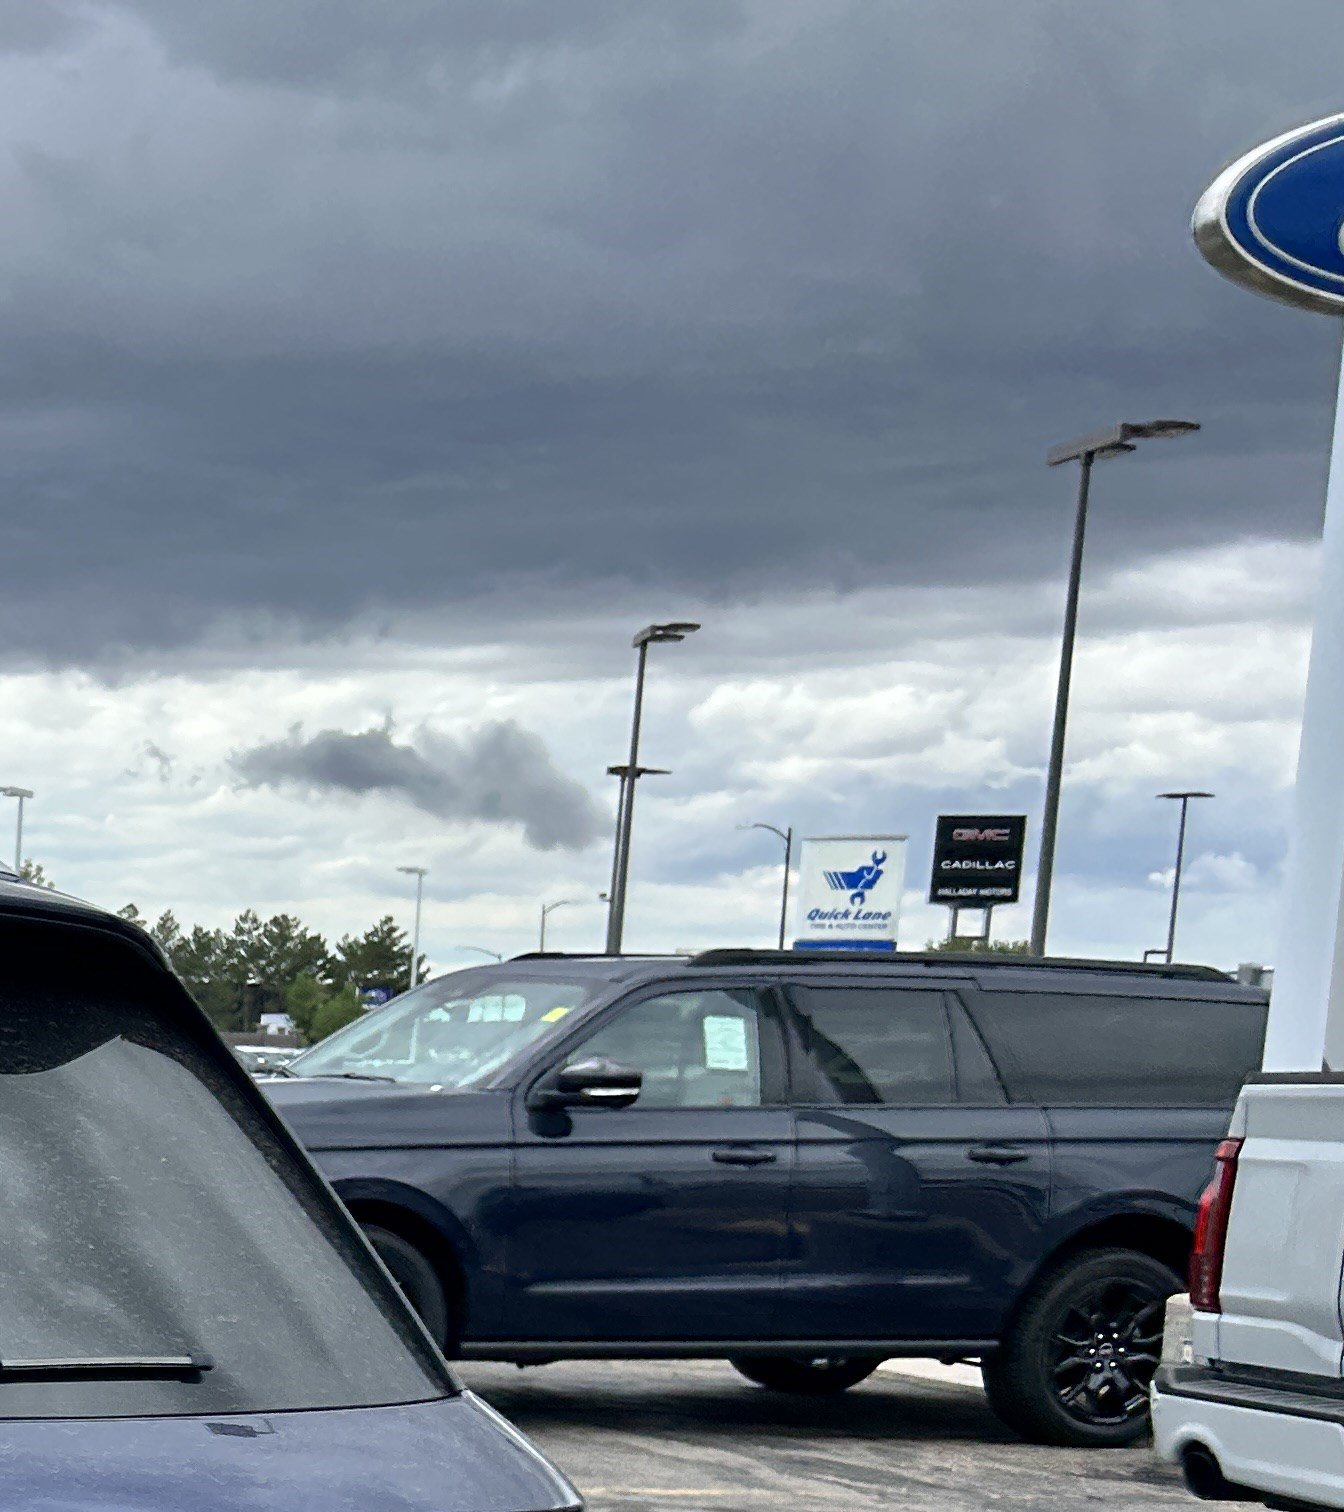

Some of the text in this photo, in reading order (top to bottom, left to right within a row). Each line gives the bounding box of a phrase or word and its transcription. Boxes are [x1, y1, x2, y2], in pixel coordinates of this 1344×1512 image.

[952, 828, 1011, 841] GMC
[941, 860, 1016, 870] CADILLAC
[807, 908, 892, 921] Quick Lane
